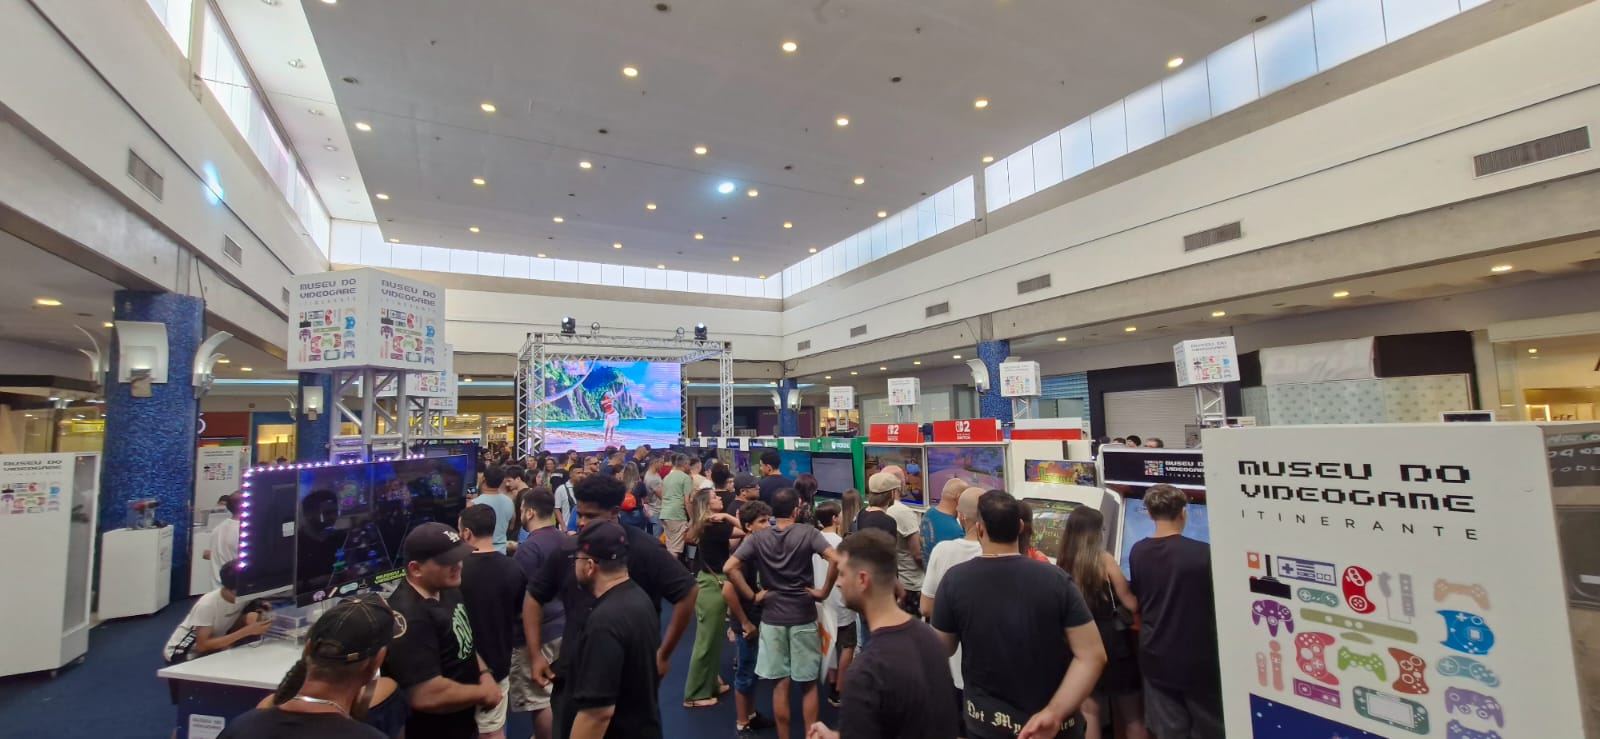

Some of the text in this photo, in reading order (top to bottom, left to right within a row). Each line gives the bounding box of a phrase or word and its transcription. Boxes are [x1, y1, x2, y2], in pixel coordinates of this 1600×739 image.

[299, 278, 357, 290] MUSEU DO
[299, 287, 357, 299] VIDEOGAME
[381, 279, 437, 299] MUSEU DO
[381, 288, 436, 307] VIDEOGAME
[1238, 460, 1471, 484] MUSEU DO
[1240, 484, 1476, 513] VIDEOGAME
[1241, 509, 1479, 541] ITINERANTE
